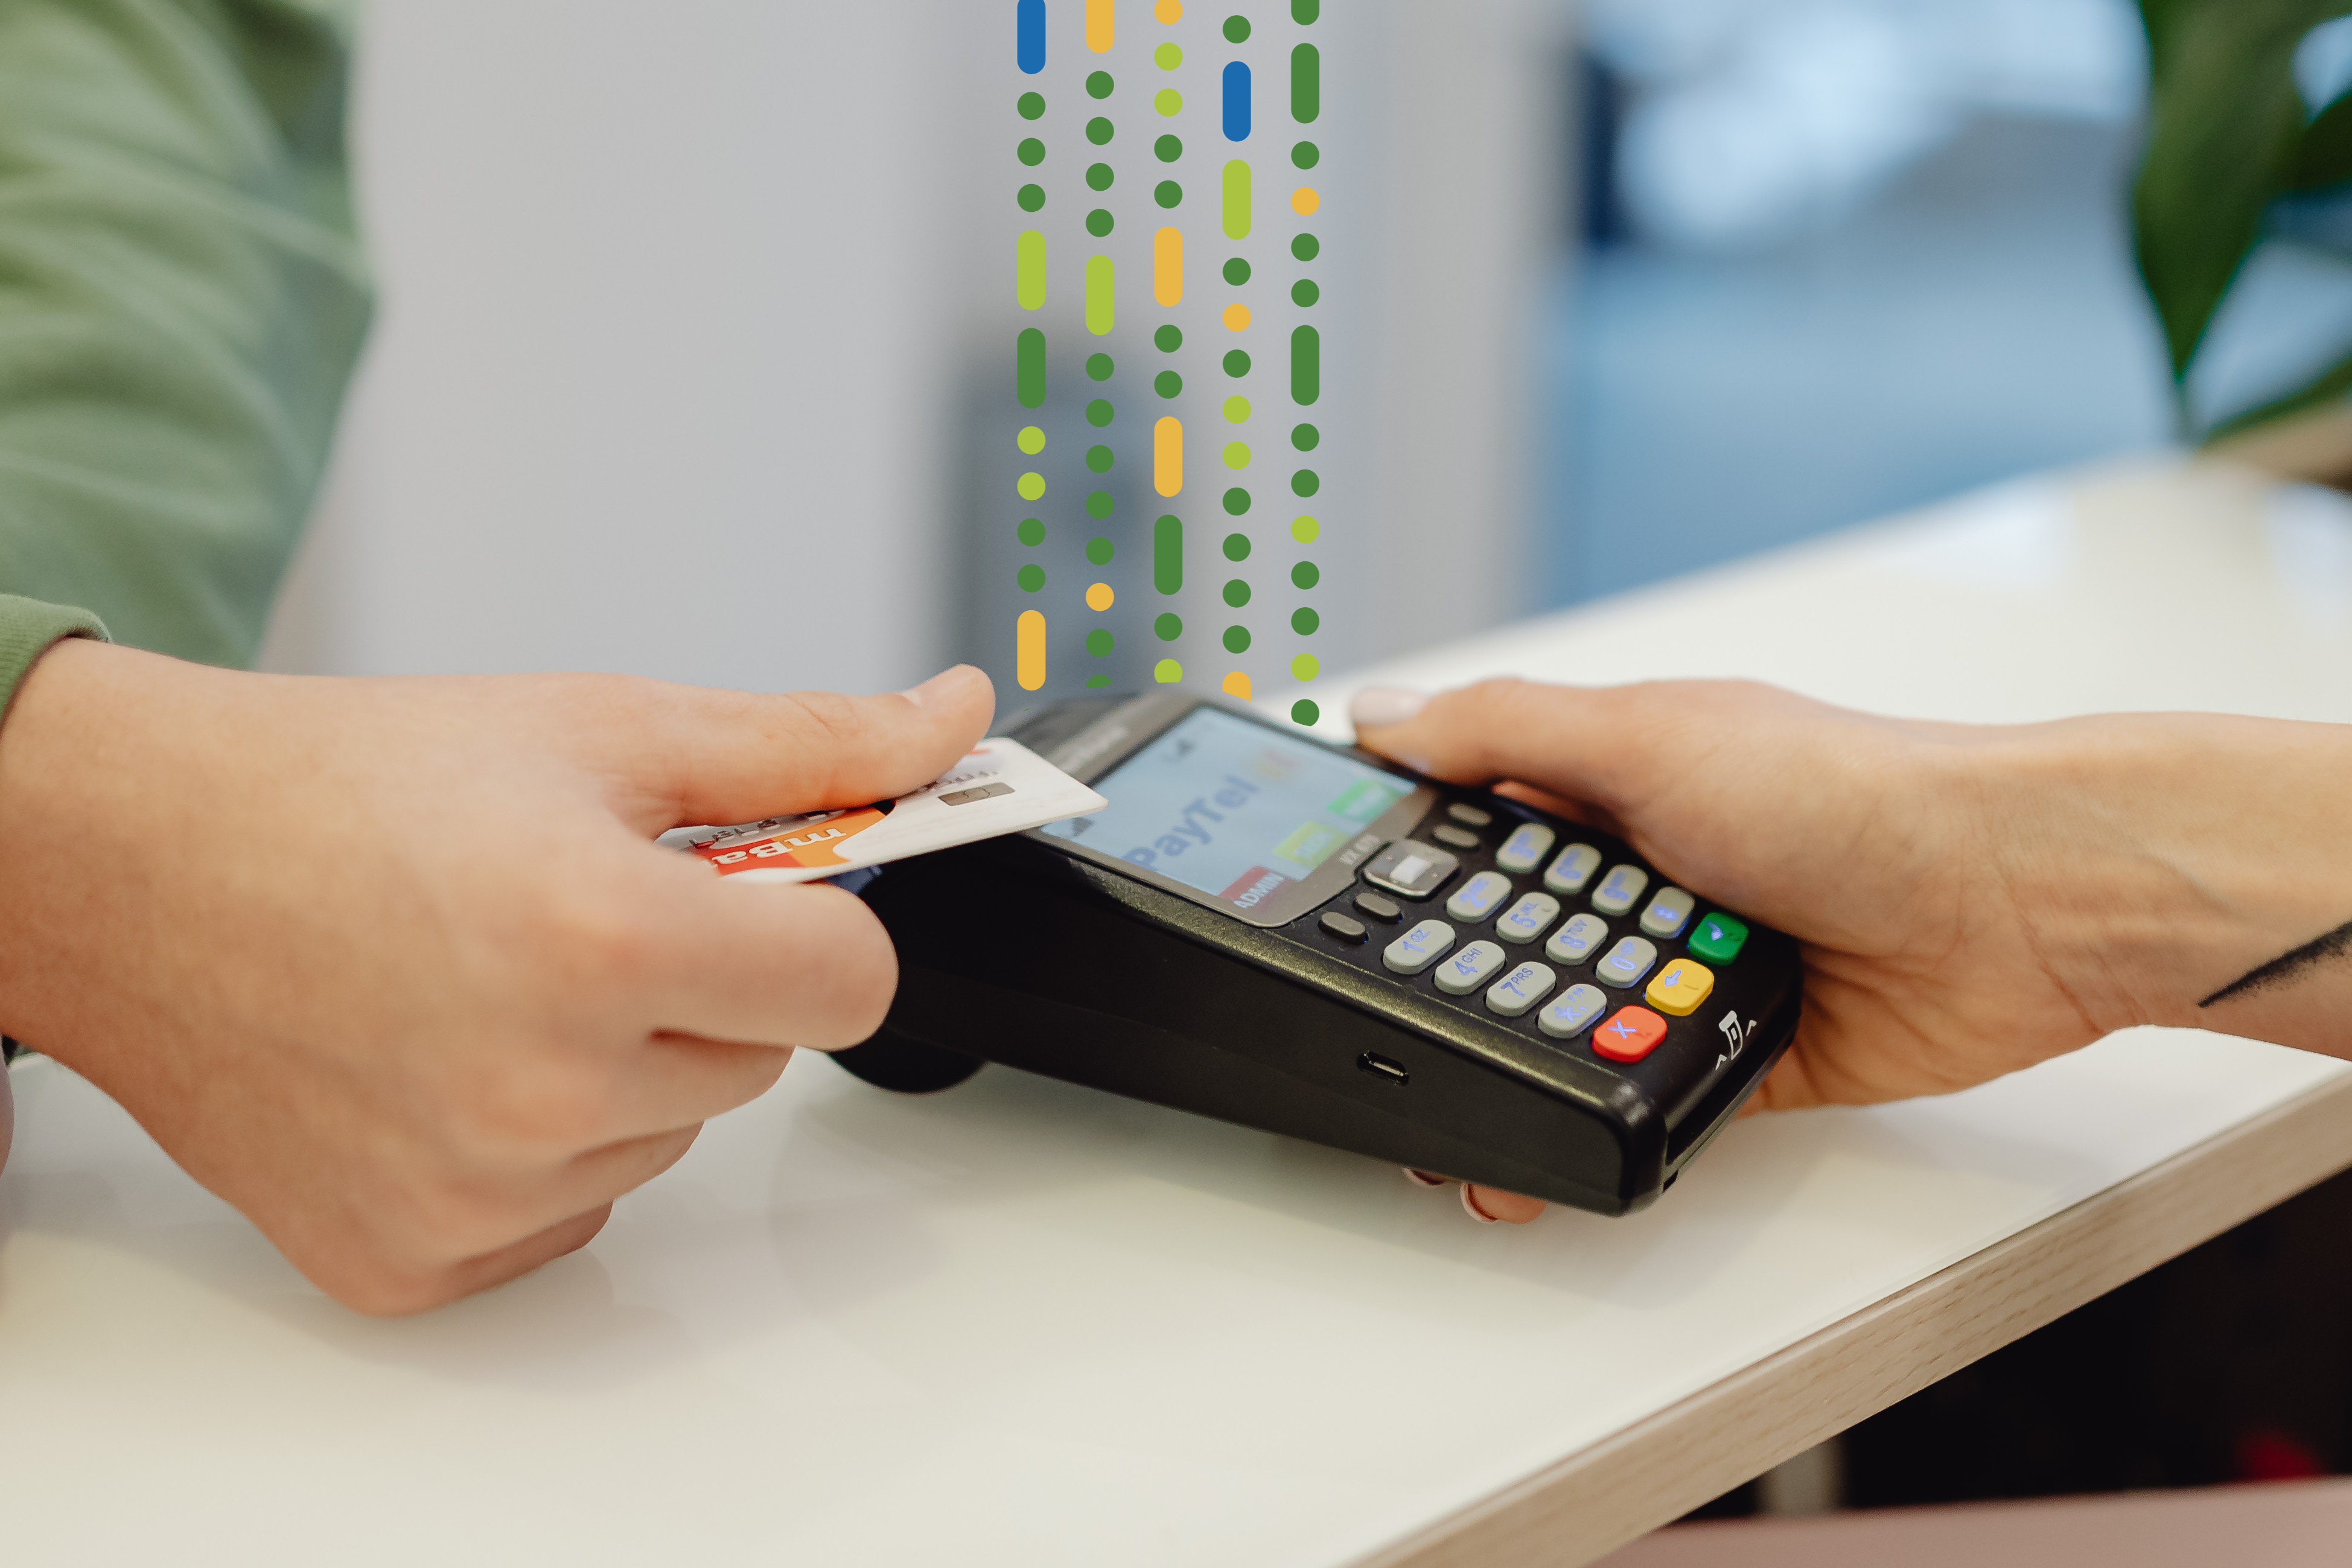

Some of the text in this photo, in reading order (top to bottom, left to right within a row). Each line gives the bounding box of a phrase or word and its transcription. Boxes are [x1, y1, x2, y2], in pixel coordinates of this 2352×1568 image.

[1121, 775, 1260, 871] PayTel
[700, 827, 847, 868] mBa
[1234, 873, 1286, 910] ADMIN
[1459, 893, 1488, 908] 2
[1511, 913, 1537, 928] 5
[1560, 919, 1588, 950] 8 TUV
[1403, 940, 1426, 954] 1
[1455, 947, 1483, 976] 4 GHI
[1610, 955, 1636, 971] 0
[1500, 967, 1534, 998] 7 PRS
